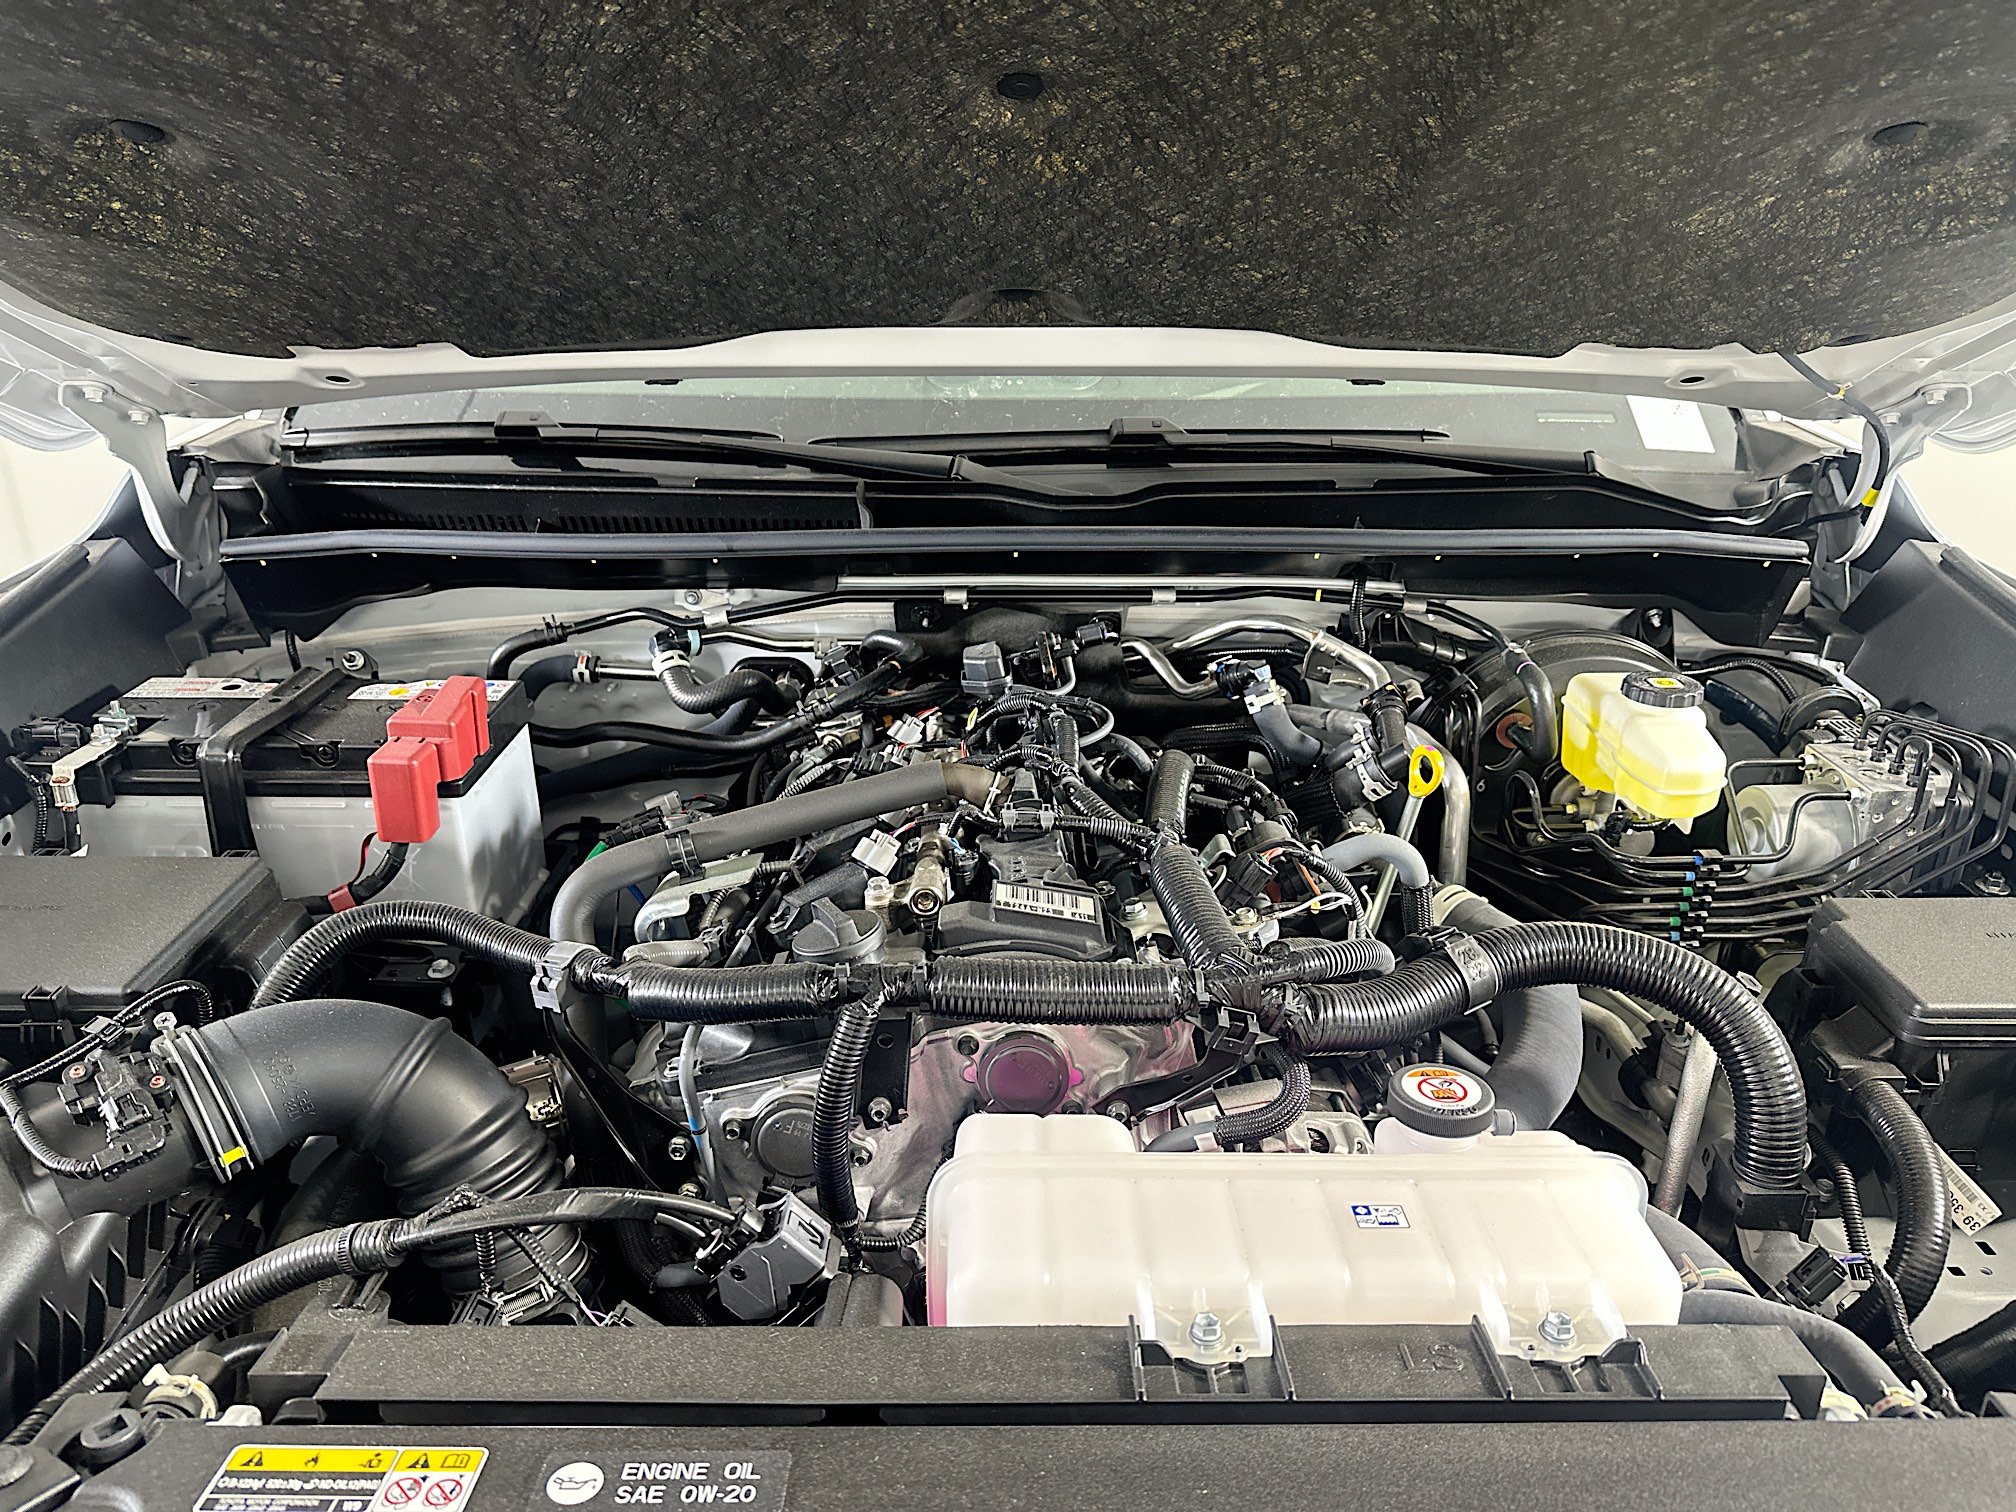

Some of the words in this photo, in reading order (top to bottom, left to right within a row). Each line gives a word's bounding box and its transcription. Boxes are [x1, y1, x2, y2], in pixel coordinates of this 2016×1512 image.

[1457, 946, 1479, 965] 28
[620, 1462, 710, 1481] ENGINE
[723, 1462, 761, 1480] OIL
[614, 1484, 666, 1504] SAE
[679, 1484, 757, 1504] 0W-20
